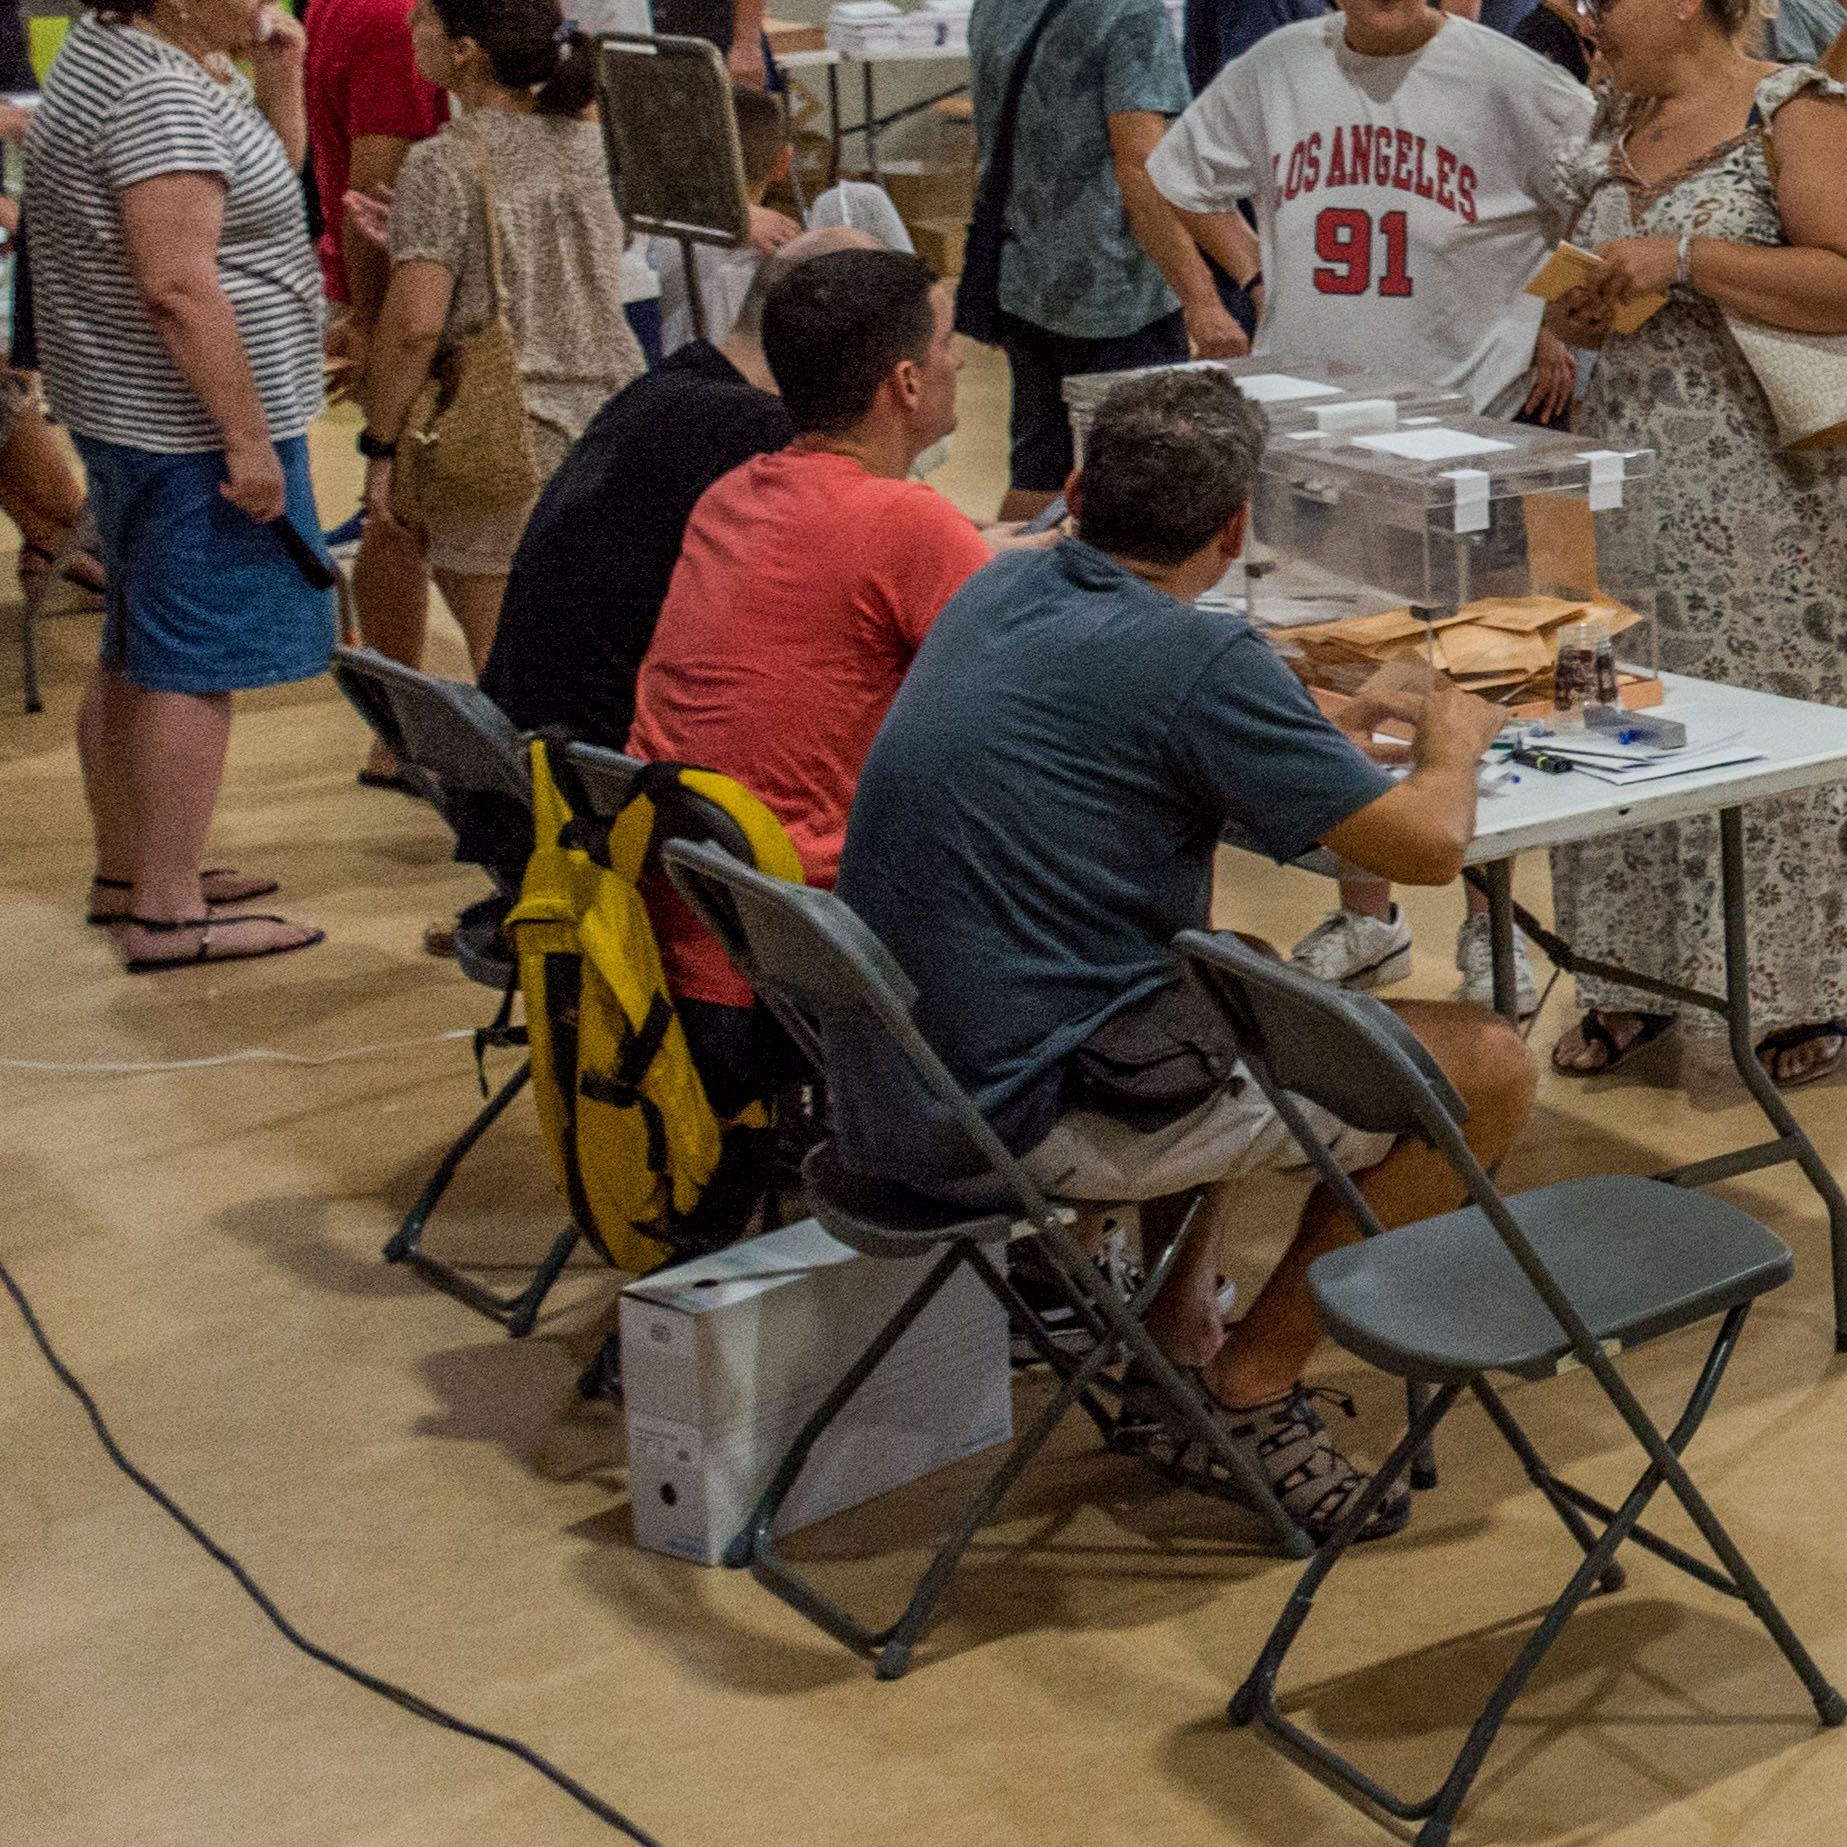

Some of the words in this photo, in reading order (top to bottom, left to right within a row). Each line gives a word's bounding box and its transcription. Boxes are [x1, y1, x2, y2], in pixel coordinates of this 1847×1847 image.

[1272, 131, 1322, 210] LOS
[1325, 123, 1478, 226] ANGELES
[1313, 207, 1413, 298] 91
